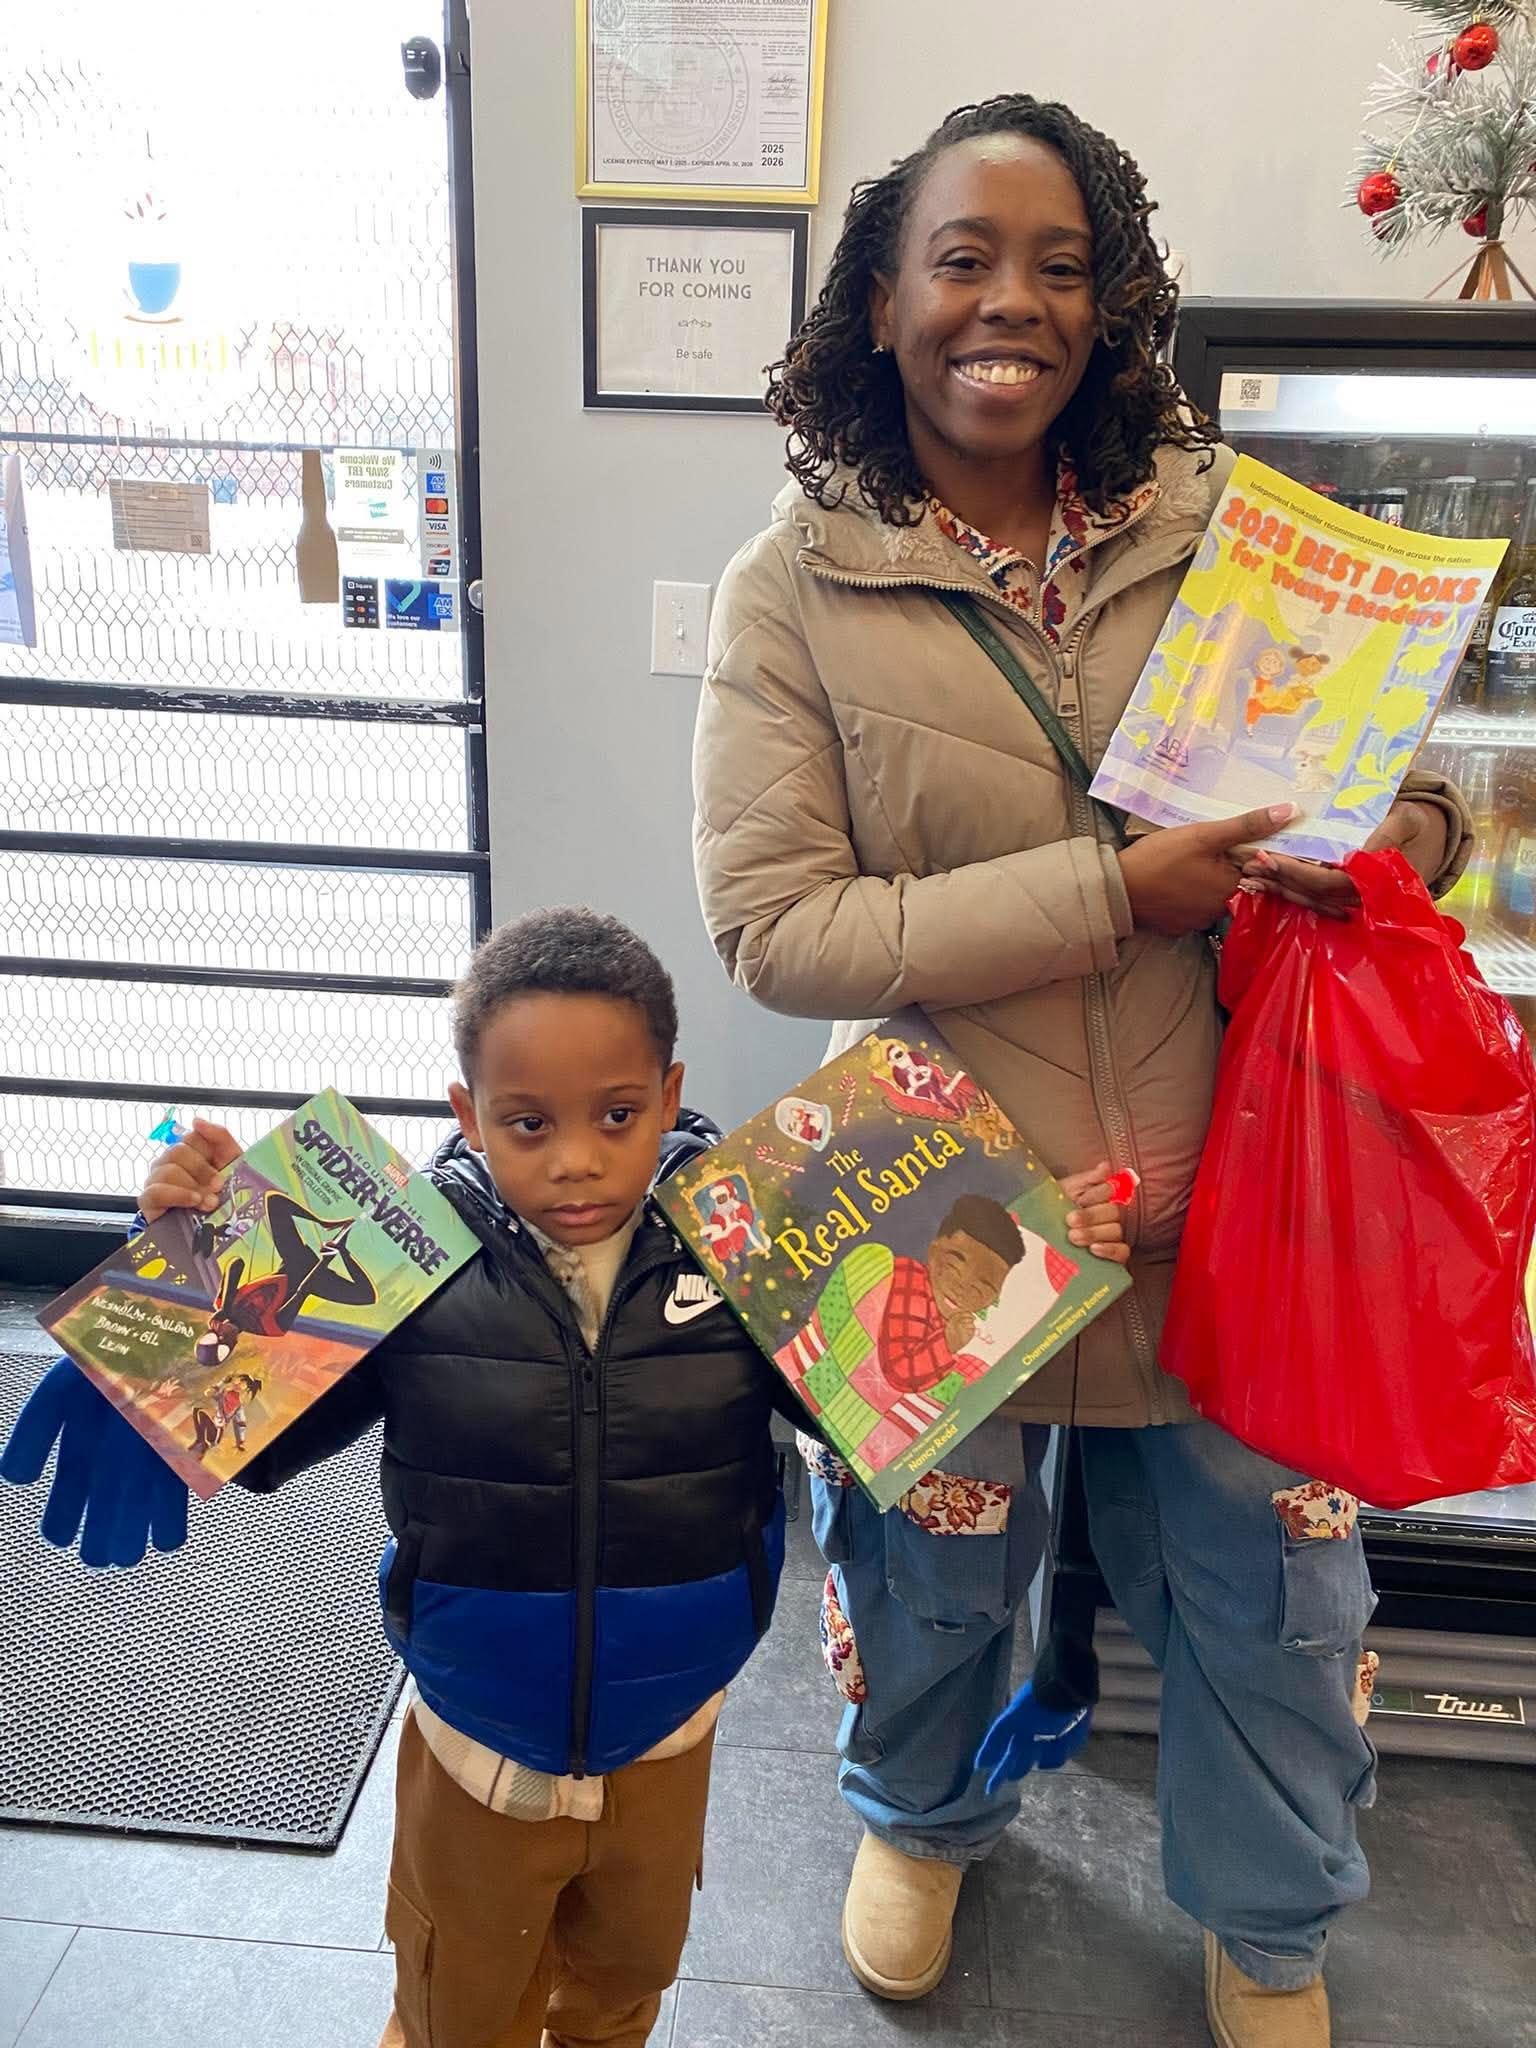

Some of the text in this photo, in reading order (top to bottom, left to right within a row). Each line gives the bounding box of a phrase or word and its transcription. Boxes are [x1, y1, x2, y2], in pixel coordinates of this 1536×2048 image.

[761, 144, 784, 154] 2025
[761, 157, 784, 167] 2026
[646, 257, 746, 275] THANK YOU
[639, 281, 752, 299] FOR COMING
[676, 348, 713, 360] Be safe
[428, 522, 447, 531] VISA
[1249, 481, 1290, 507] Independent
[1289, 501, 1323, 526] bookseller
[1323, 520, 1386, 550] recommendations
[1387, 545, 1405, 557] from
[1405, 551, 1432, 561] across
[1433, 555, 1445, 563] the
[1221, 496, 1482, 604] 2025 BEST BOOKS
[1229, 538, 1265, 573] for
[1270, 561, 1341, 614] Young
[1345, 593, 1445, 628] Readers
[435, 597, 453, 606] AM
[437, 607, 453, 616] EX
[1156, 735, 1190, 762] ABA
[826, 1149, 864, 1177] The
[293, 1119, 450, 1277] SPIDER-VERSE
[304, 1176, 332, 1206] COLLECTION
[346, 1145, 427, 1224] AROUND THE
[774, 1186, 872, 1281] Real
[856, 1128, 966, 1214] Santa
[96, 1316, 159, 1347] BROWN GIL
[908, 1423, 959, 1472] Nancy Redd
[1424, 1693, 1515, 1719] true
